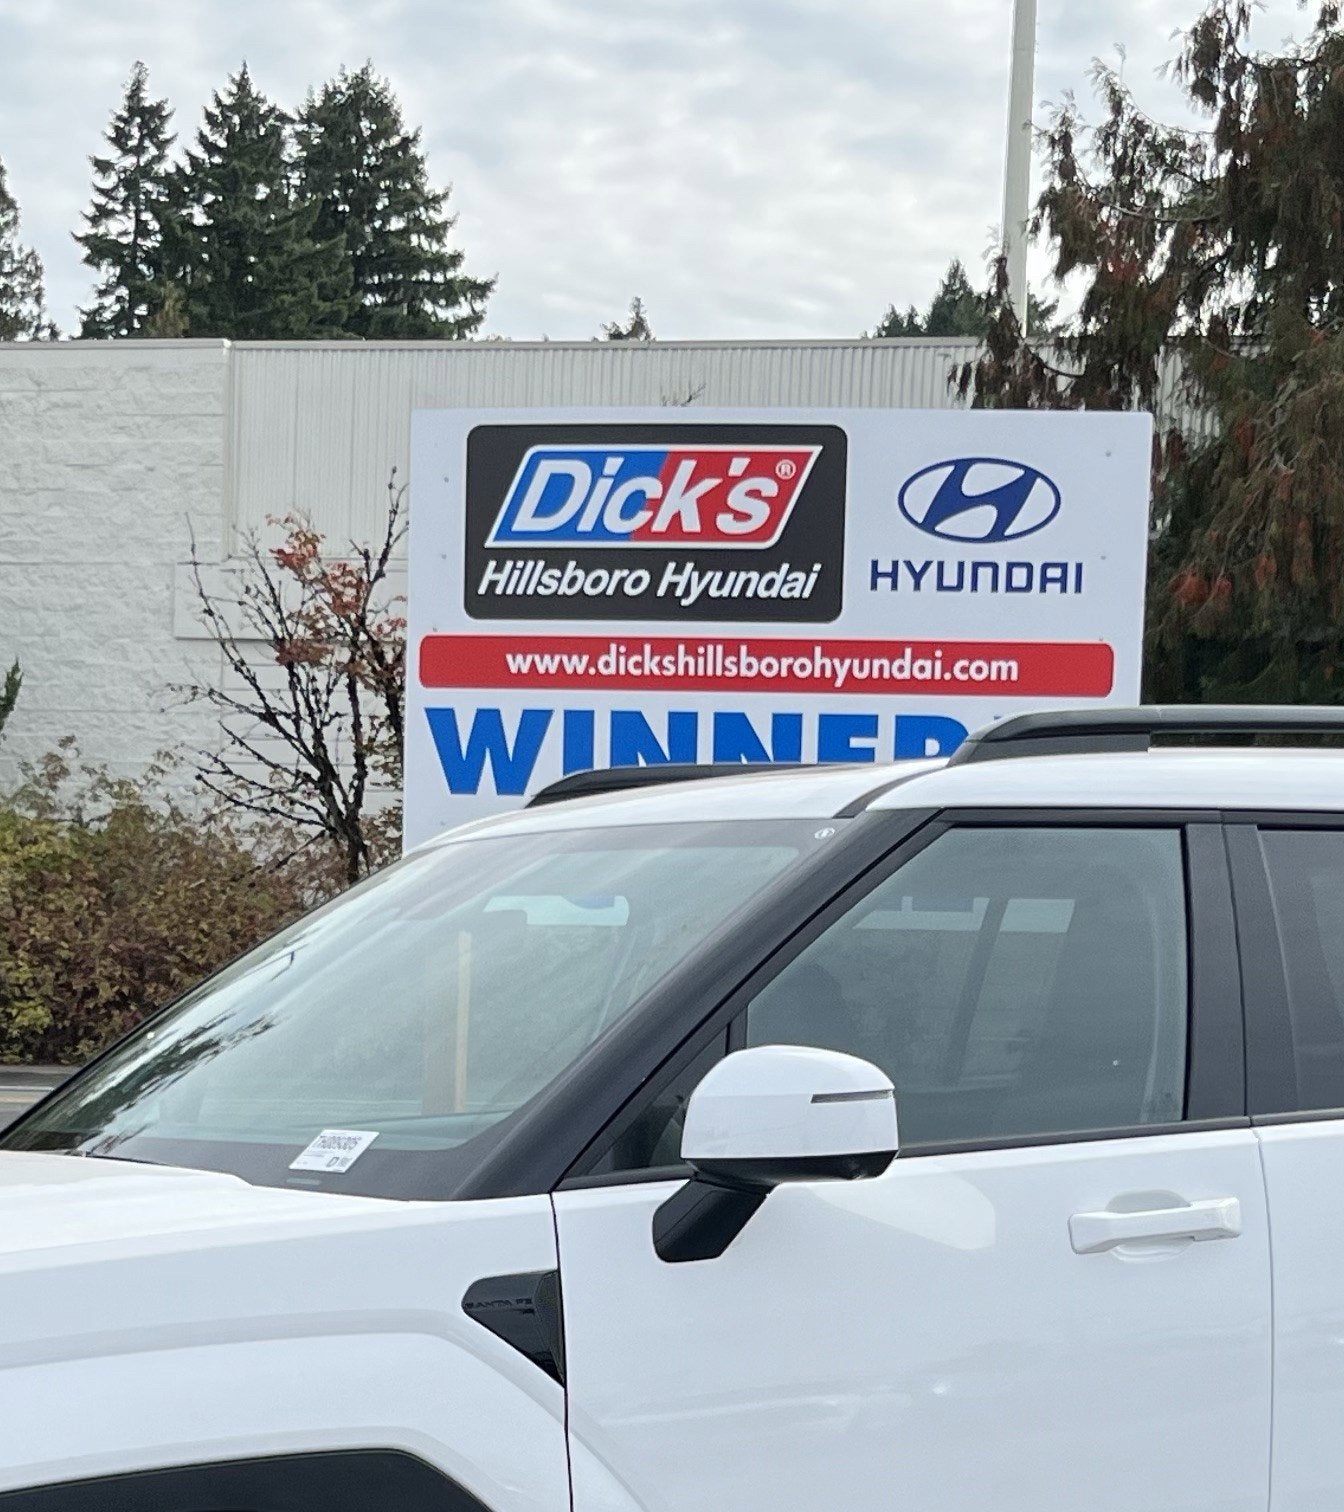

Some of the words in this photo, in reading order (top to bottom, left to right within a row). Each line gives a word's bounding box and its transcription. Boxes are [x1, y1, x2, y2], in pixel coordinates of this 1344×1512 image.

[477, 560, 651, 596] Hillsboro
[656, 561, 822, 606] Hyundai
[870, 559, 1083, 594] HYUNDAI
[505, 643, 1018, 688] www.dickshillsborohyundai.com
